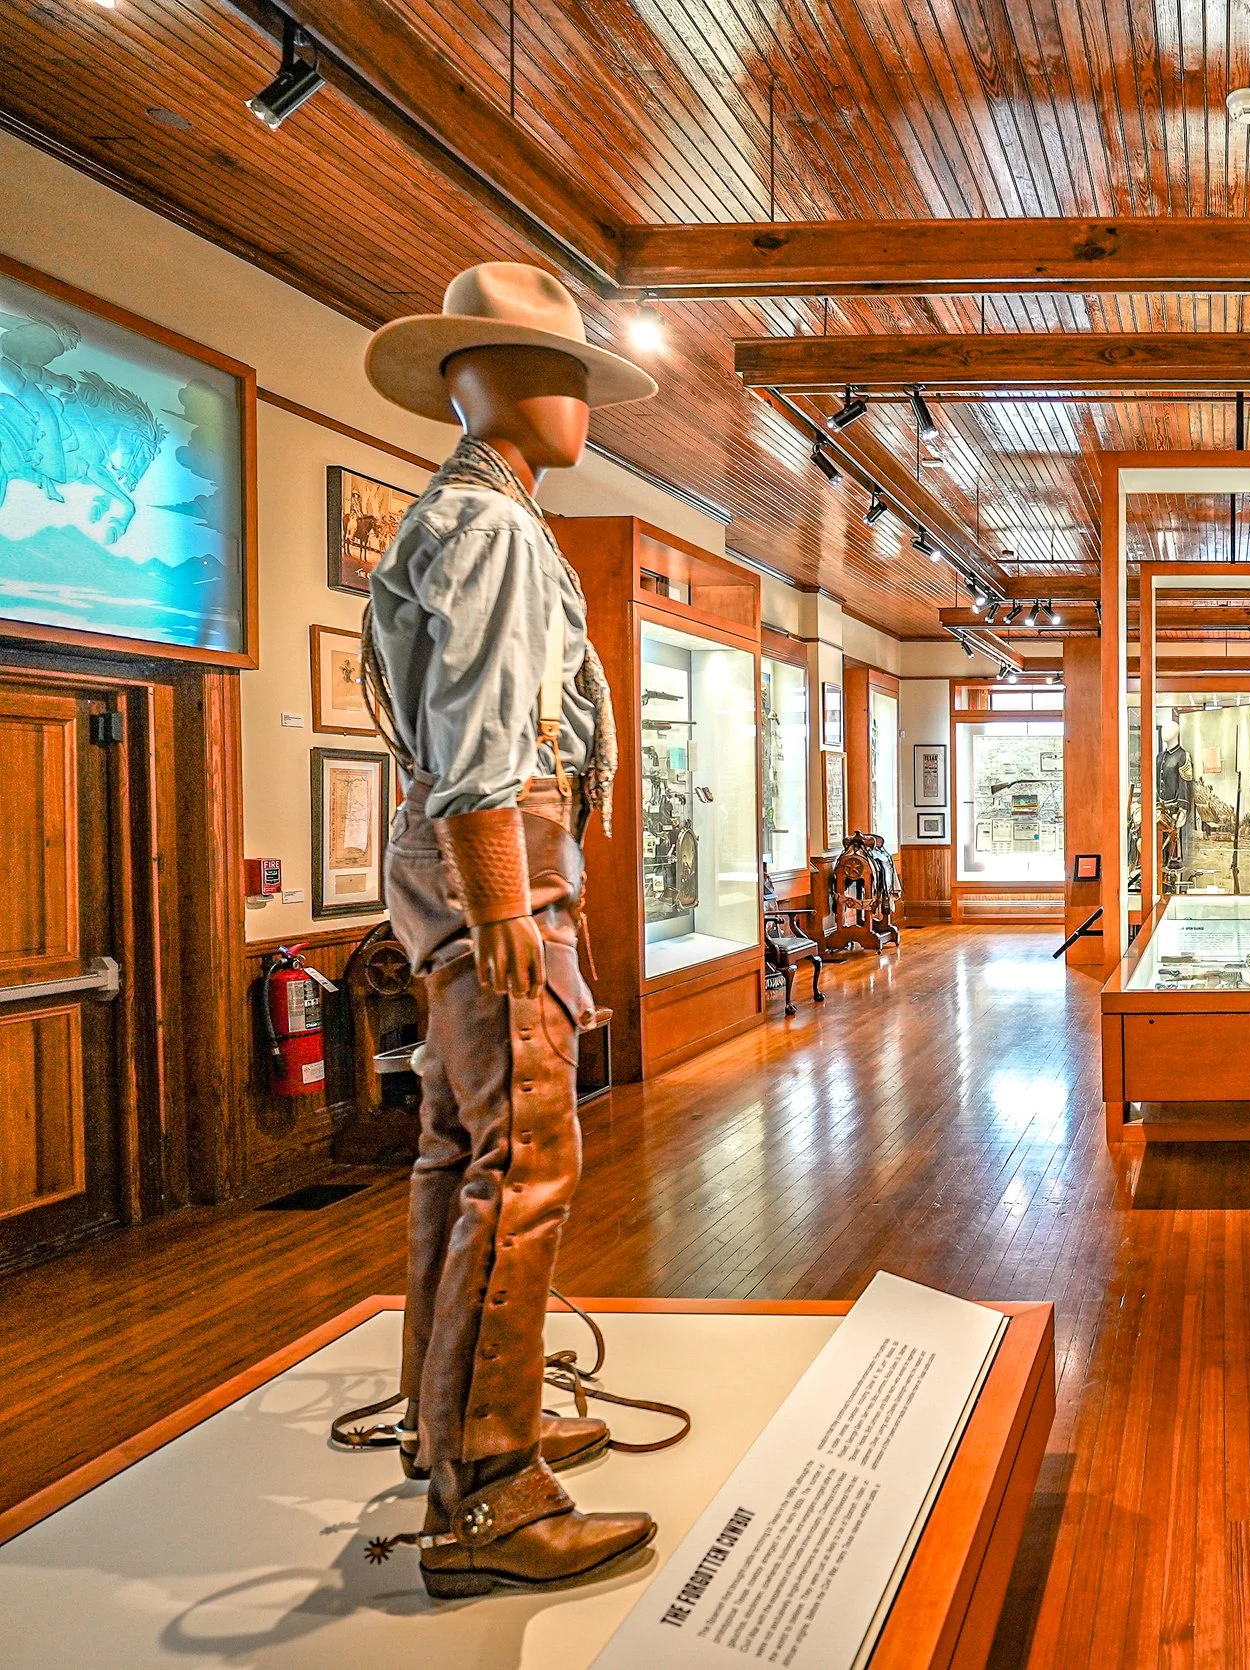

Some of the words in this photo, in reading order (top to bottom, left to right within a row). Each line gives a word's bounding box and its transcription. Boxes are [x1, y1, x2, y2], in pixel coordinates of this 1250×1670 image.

[659, 1603, 691, 1628] THE
[675, 1545, 729, 1605] FORGOTTEN
[714, 1506, 756, 1548] COWBOY
